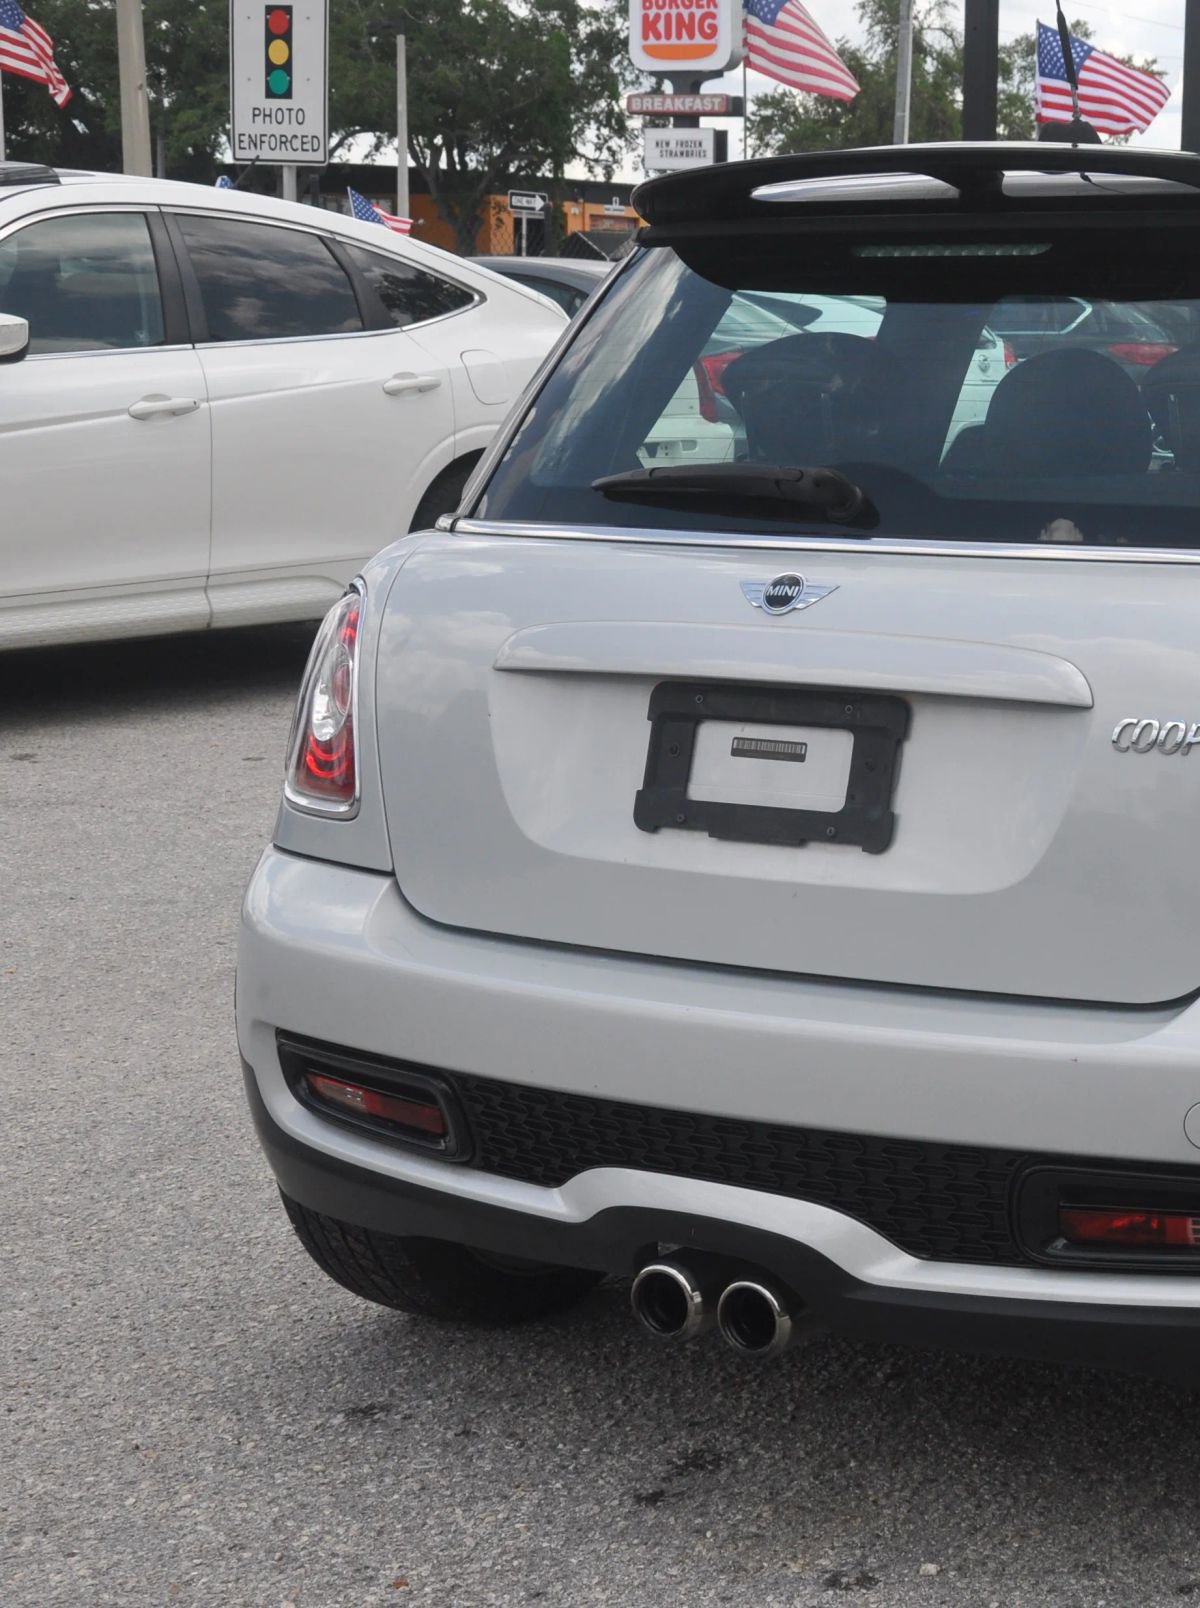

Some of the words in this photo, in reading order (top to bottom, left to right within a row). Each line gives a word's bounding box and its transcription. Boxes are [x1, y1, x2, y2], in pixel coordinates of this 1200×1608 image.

[642, 11, 718, 41] KING
[631, 96, 721, 111] BREAKFAST
[252, 107, 305, 125] PHOTO
[238, 133, 321, 152] ENFORCED
[655, 140, 670, 148] NEW
[675, 140, 703, 148] FROZEN
[766, 585, 799, 597] MINI
